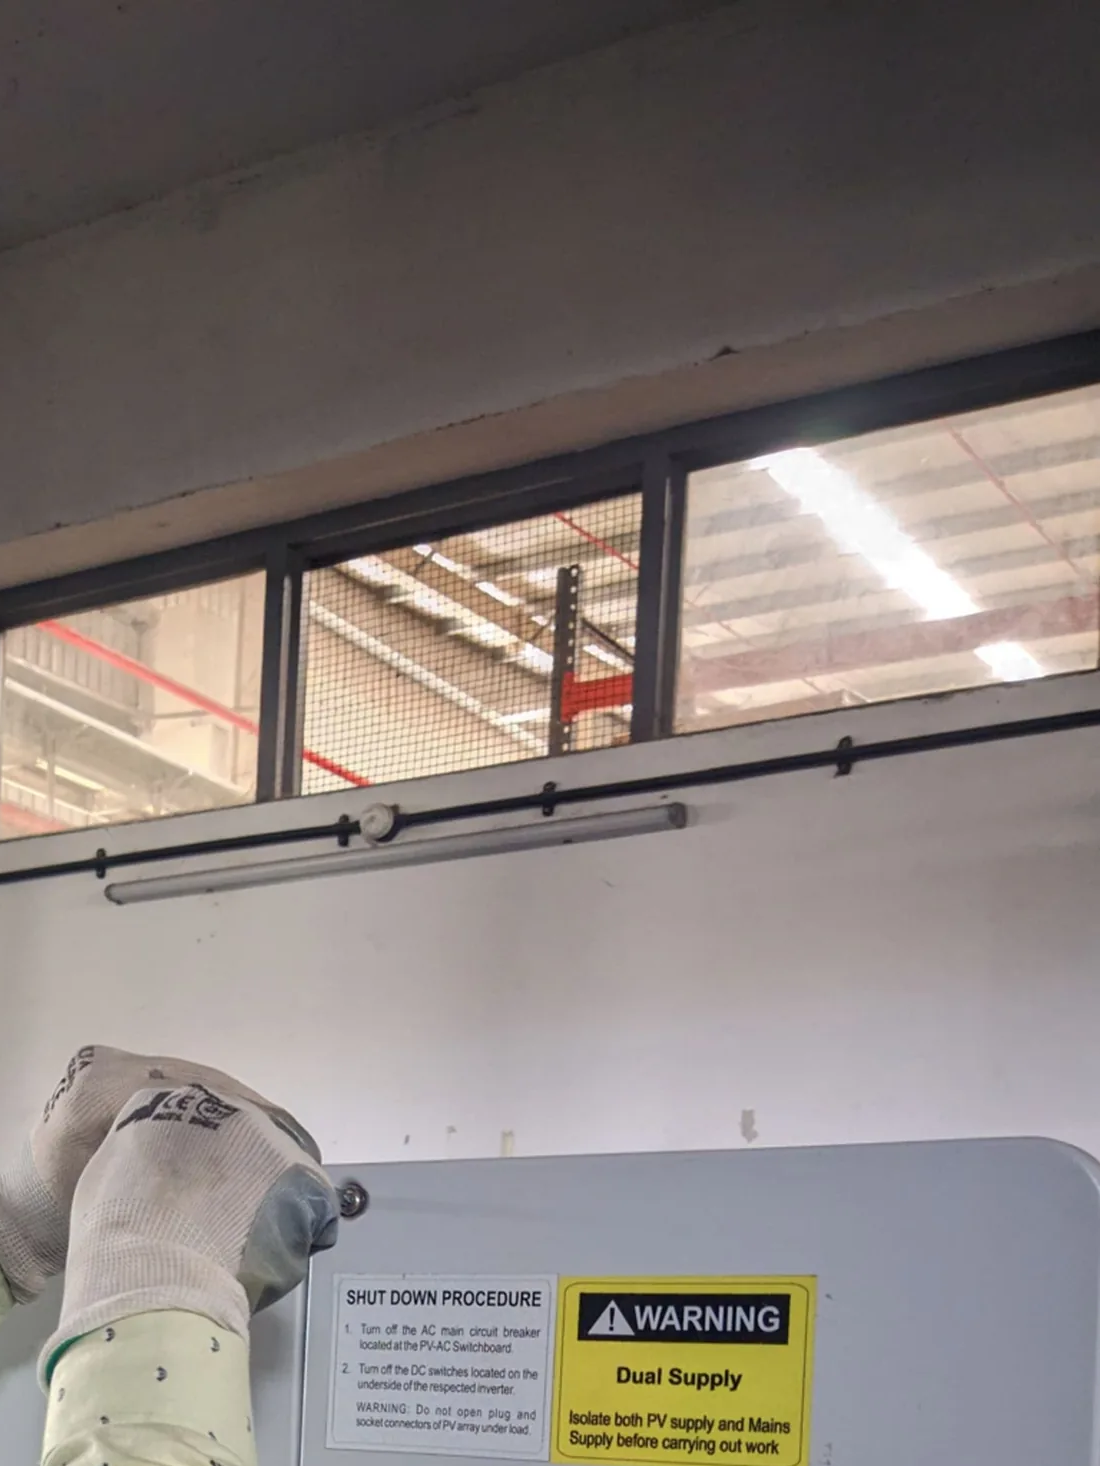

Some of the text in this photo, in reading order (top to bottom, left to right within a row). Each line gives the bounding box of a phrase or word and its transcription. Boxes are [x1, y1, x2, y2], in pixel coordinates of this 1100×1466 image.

[346, 1289, 542, 1307] SHUT DOWN PROCEDURE
[635, 1305, 781, 1332] WARNING
[361, 1323, 380, 1335] Turn
[385, 1324, 398, 1335] off
[402, 1325, 417, 1336] the
[421, 1325, 436, 1336] AC
[441, 1326, 464, 1337] main
[469, 1326, 498, 1338] circuit
[503, 1326, 540, 1338] breaker
[359, 1339, 392, 1350] located
[393, 1340, 402, 1351] at
[404, 1340, 418, 1352] the
[420, 1340, 451, 1353] PV-AC
[359, 1362, 379, 1375] Turn
[381, 1363, 393, 1375] off
[394, 1364, 409, 1376] the
[411, 1364, 426, 1376] DC
[428, 1365, 469, 1377] switches
[471, 1366, 506, 1379] located
[508, 1369, 520, 1379] on
[522, 1368, 538, 1380] the
[616, 1366, 743, 1392] Dual Supply
[357, 1379, 402, 1391] underside
[403, 1380, 413, 1392] of
[413, 1380, 428, 1392] the
[429, 1381, 476, 1395] respected
[416, 1403, 430, 1415] Do
[435, 1406, 451, 1416] not
[457, 1407, 482, 1419] open
[488, 1408, 511, 1422] plug
[517, 1410, 537, 1421] and
[569, 1410, 791, 1434] Isolate both PV supply and Mains
[356, 1417, 384, 1427] socket
[384, 1419, 432, 1430] connectors
[432, 1420, 442, 1430] of
[443, 1420, 456, 1431] PV
[457, 1422, 480, 1436] array
[481, 1423, 508, 1434] under
[569, 1431, 780, 1455] Supply before carrying out work
